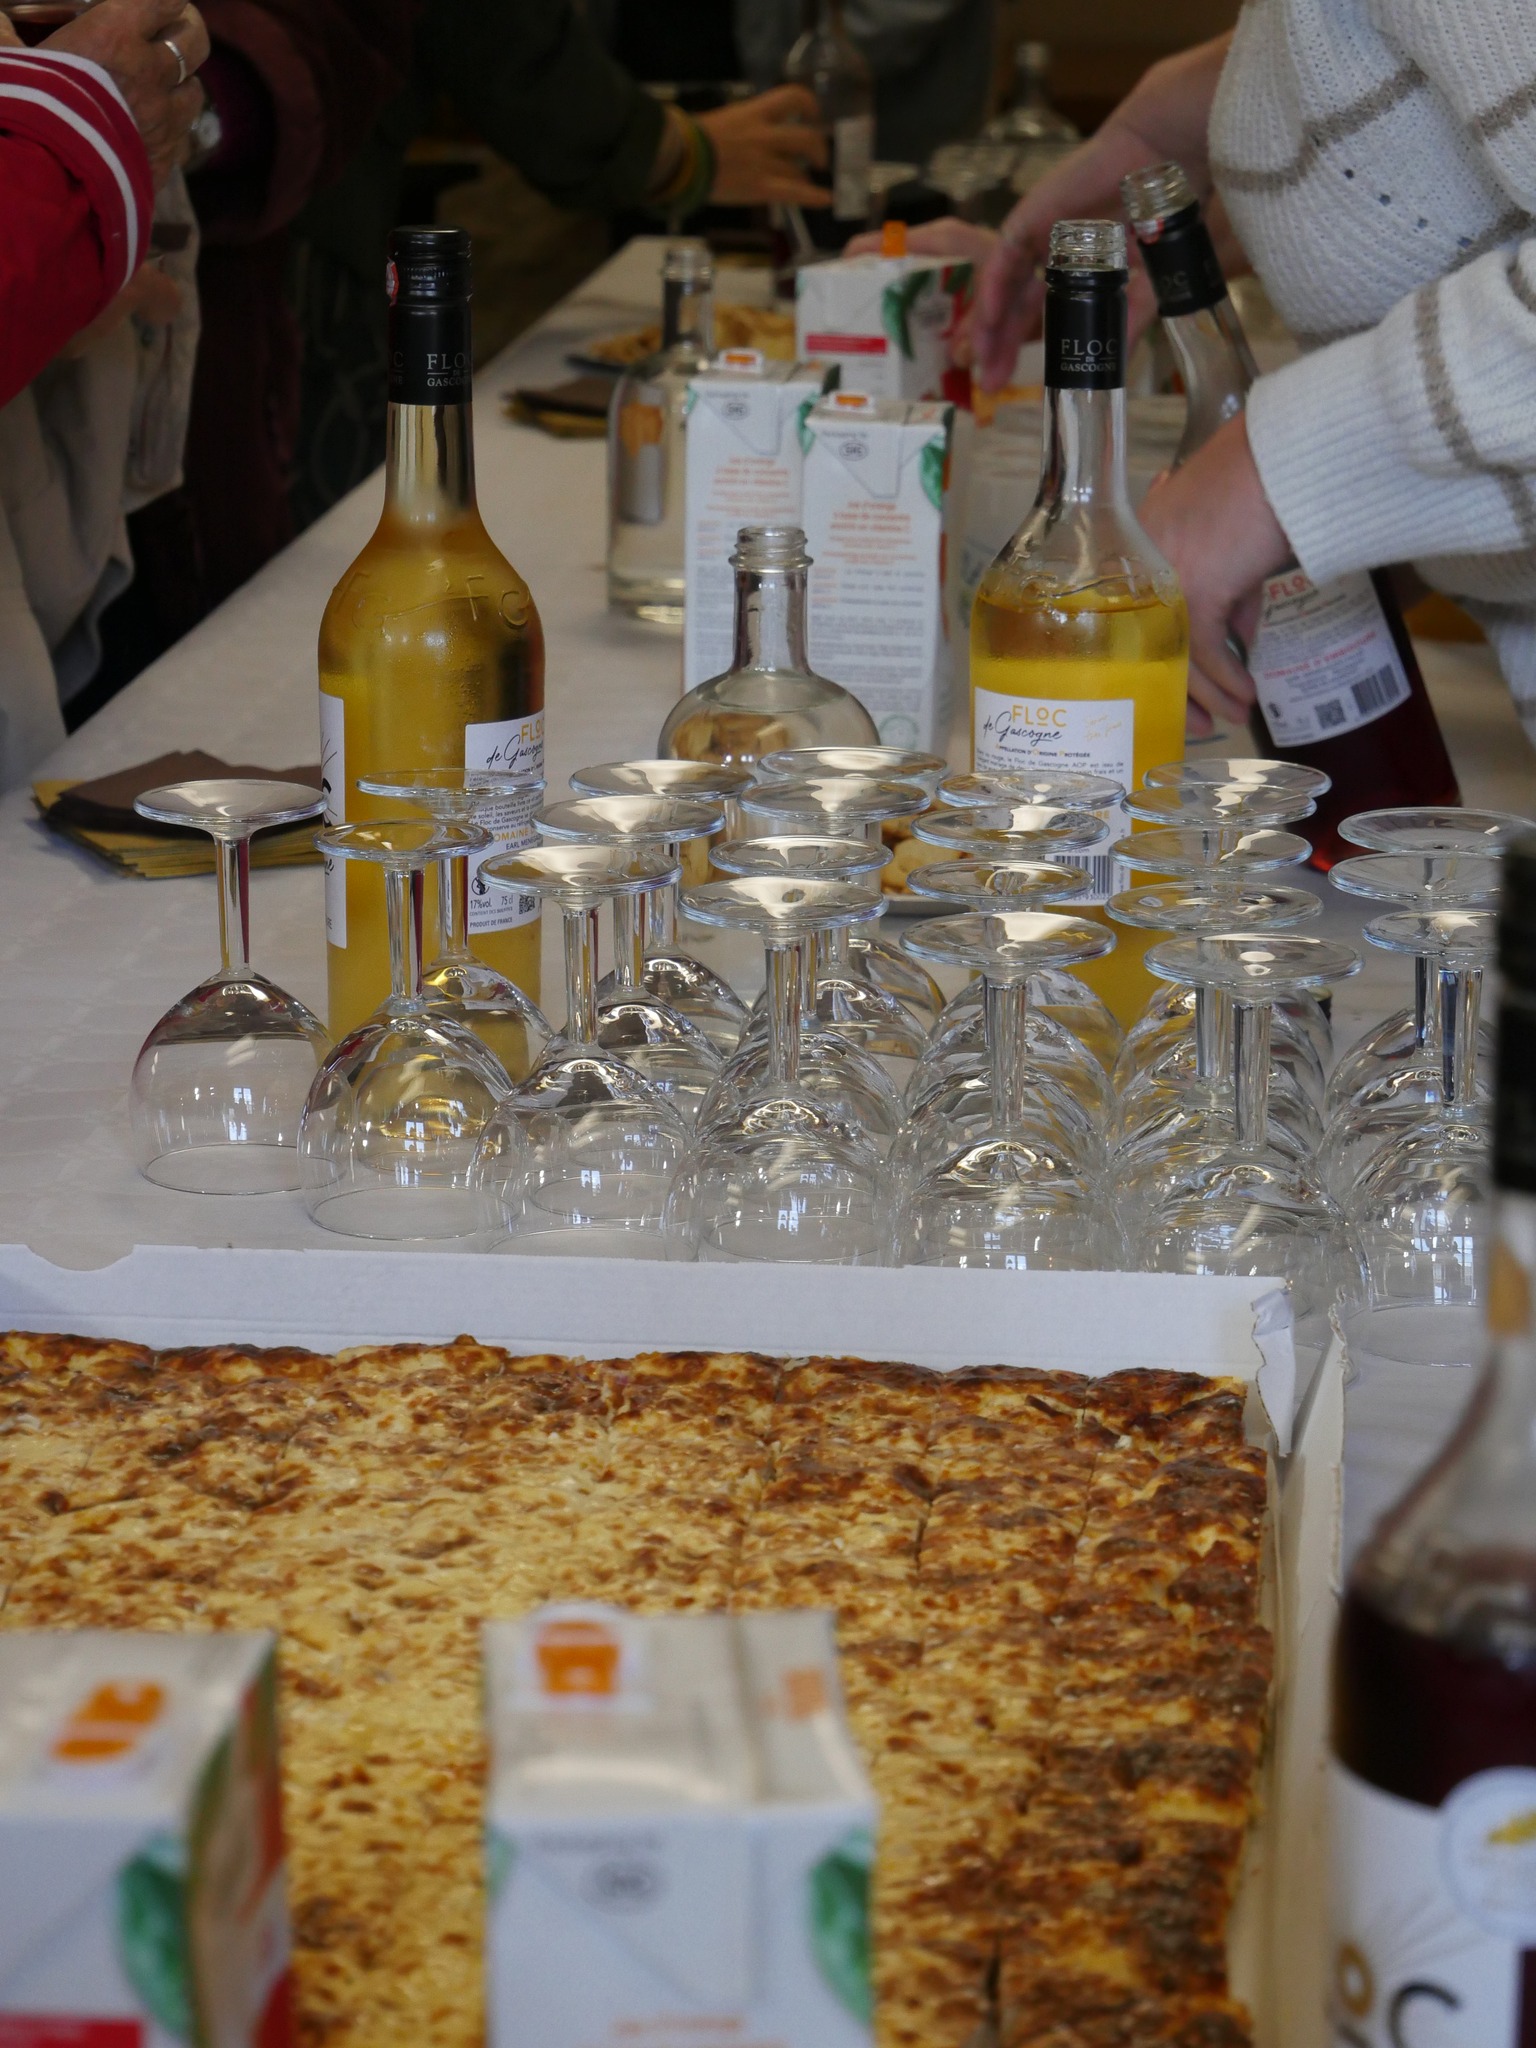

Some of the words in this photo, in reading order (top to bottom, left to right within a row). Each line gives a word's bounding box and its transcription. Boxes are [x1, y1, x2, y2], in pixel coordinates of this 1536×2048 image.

[1061, 339, 1117, 356] FLOC
[426, 353, 468, 370] FLO
[1268, 574, 1306, 600] FLO
[1011, 704, 1067, 728] FLOC
[983, 714, 993, 738] de
[994, 710, 1063, 747] Gascogne
[486, 745, 502, 769] de
[493, 828, 529, 842] OMAINE
[470, 920, 490, 928] PRODUIT
[497, 916, 513, 924] FRANCE
